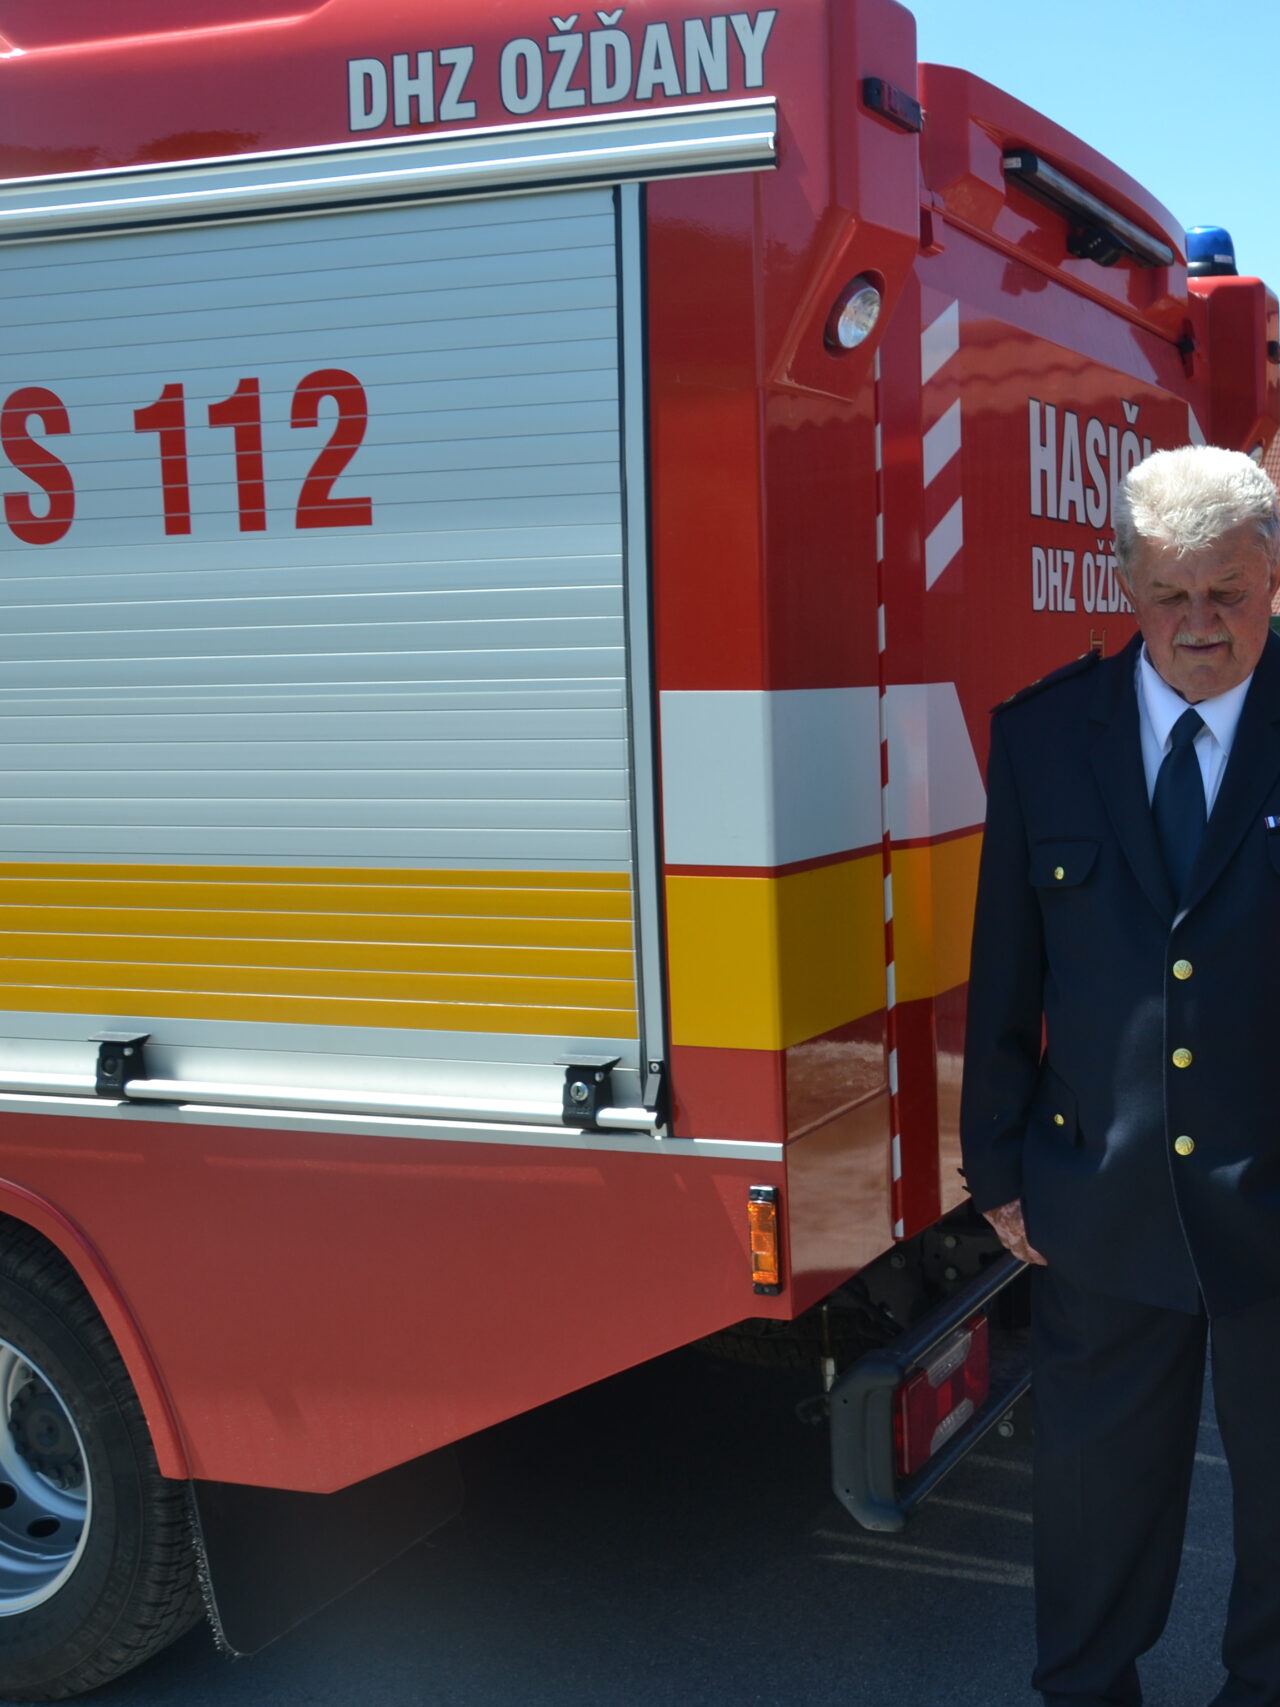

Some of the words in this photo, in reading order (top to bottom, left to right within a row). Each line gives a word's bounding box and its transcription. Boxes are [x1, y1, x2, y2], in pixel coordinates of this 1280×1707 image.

[347, 45, 478, 132] DHZ
[499, 8, 778, 116] OŽĎANY
[0, 386, 76, 546] S
[133, 368, 373, 537] 112
[1028, 397, 1153, 530] HASIČ
[1031, 545, 1078, 613] DHZ
